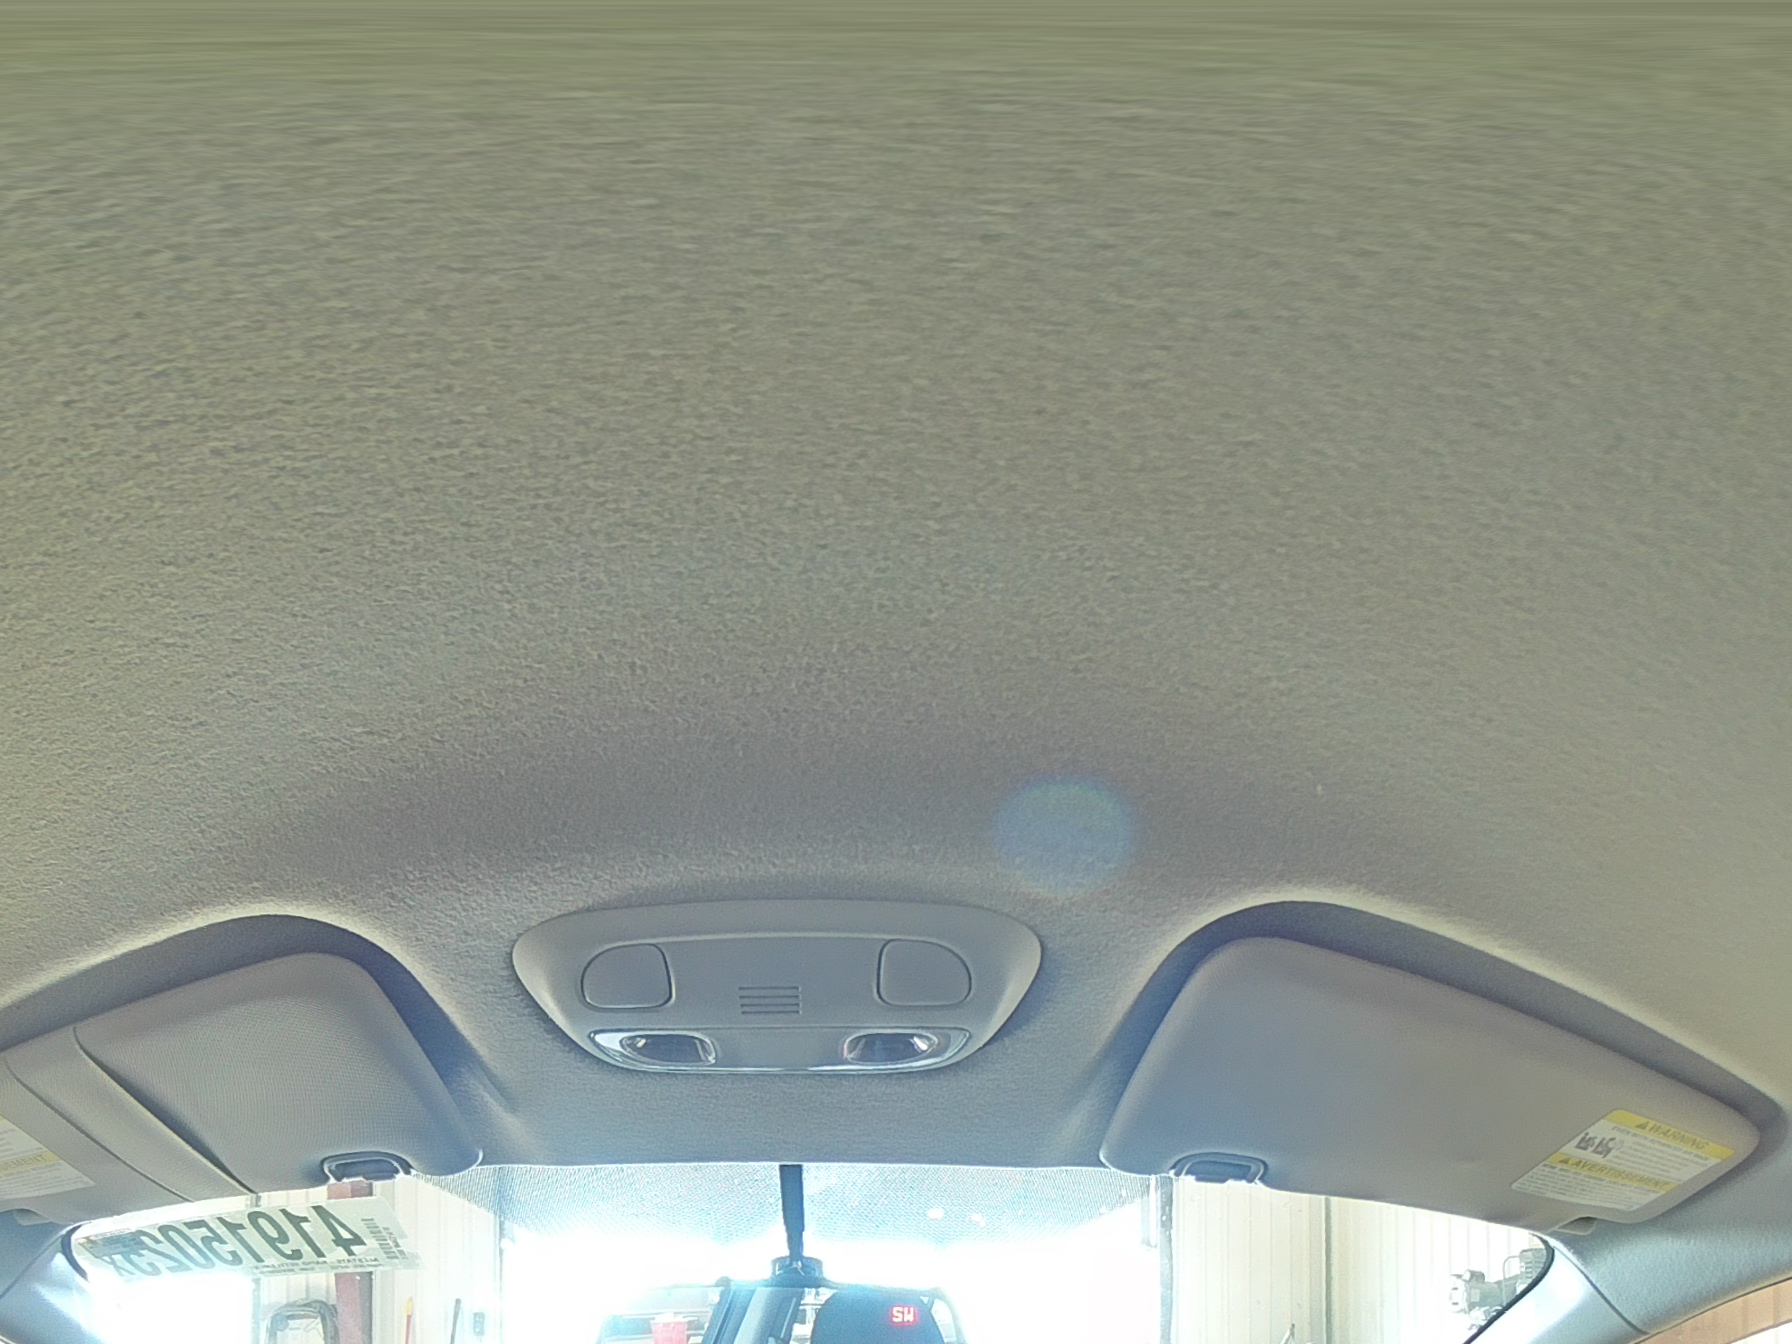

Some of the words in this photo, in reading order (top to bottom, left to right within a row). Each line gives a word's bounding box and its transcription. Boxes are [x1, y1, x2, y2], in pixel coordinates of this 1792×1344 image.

[1648, 1122, 1706, 1150] WARNING
[1570, 1159, 1674, 1190] AVERTISSEMENT
[892, 1306, 914, 1322] SW
